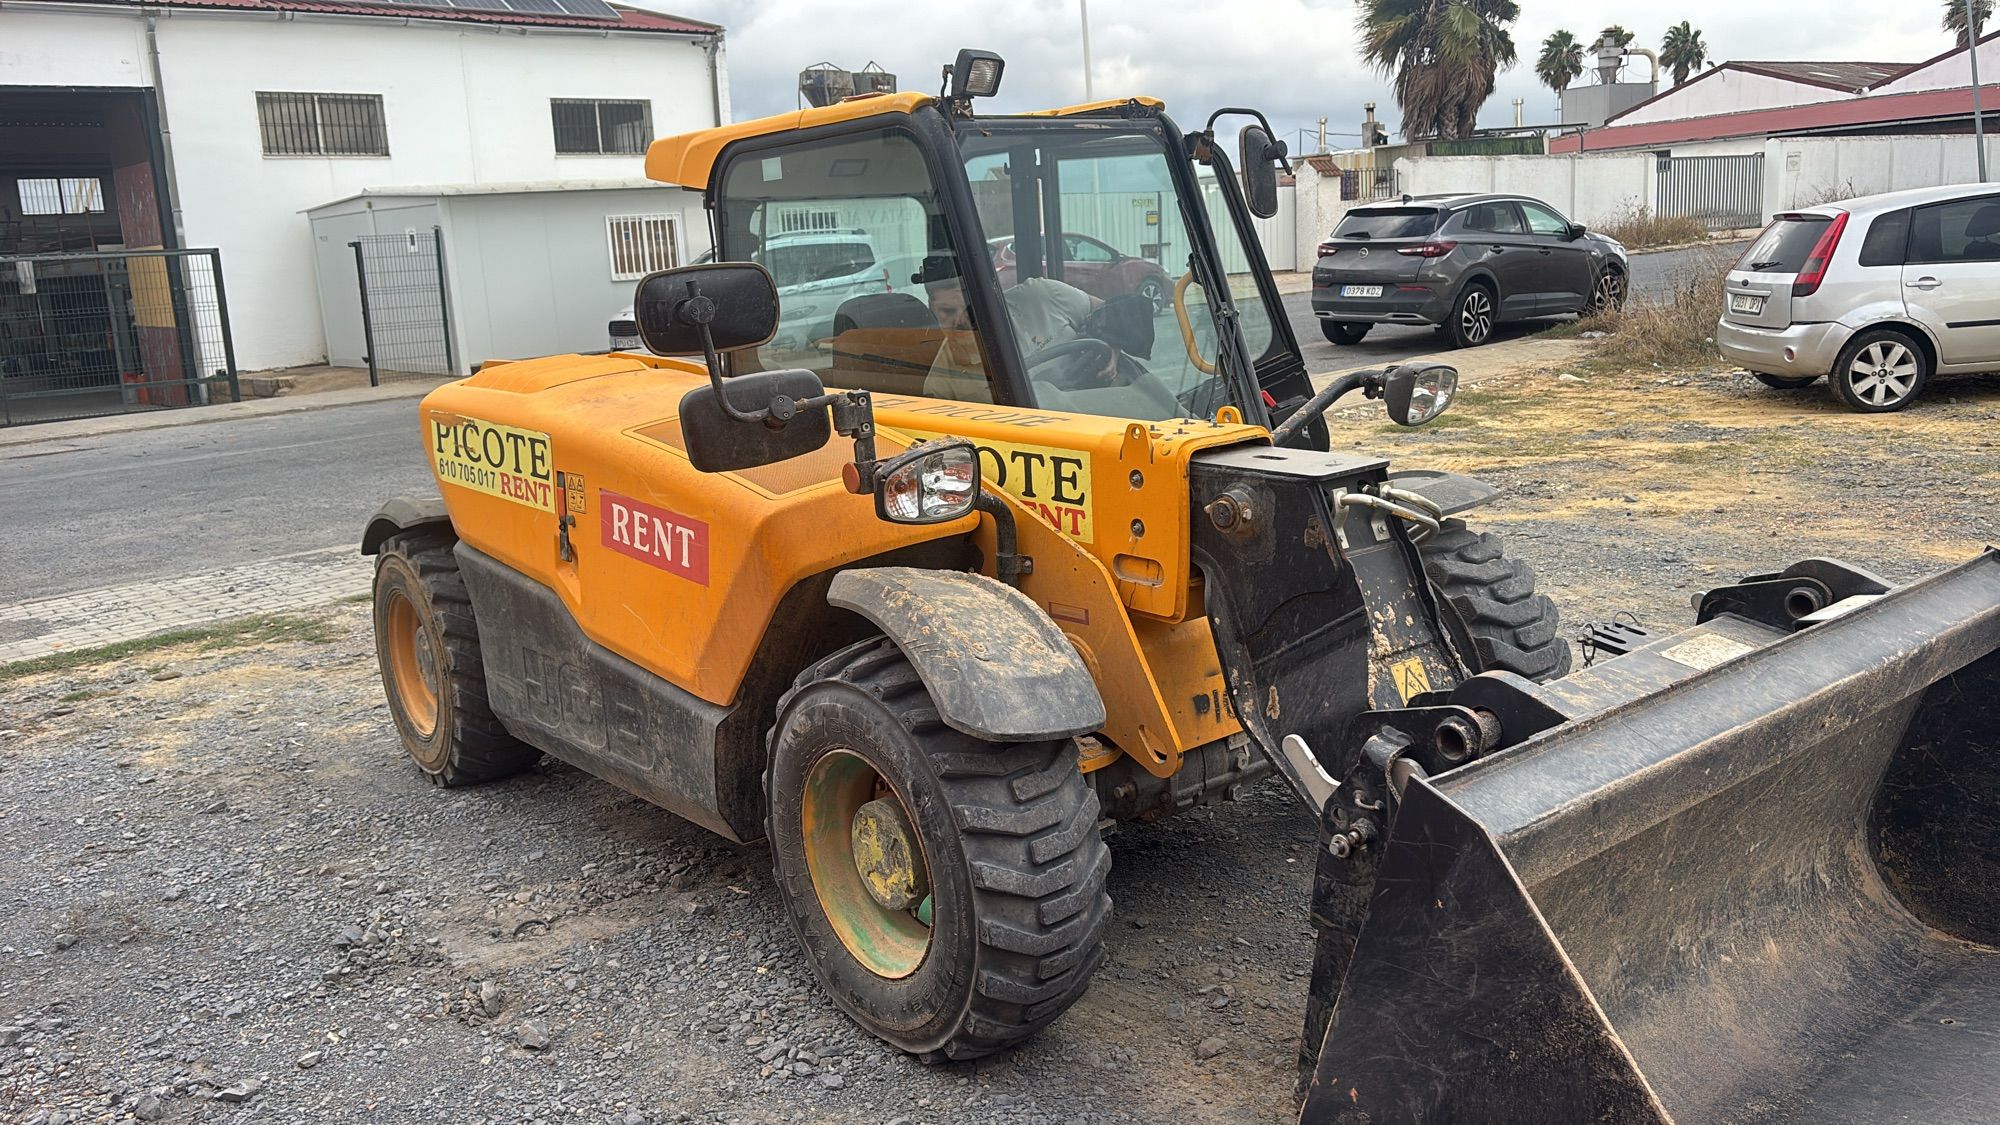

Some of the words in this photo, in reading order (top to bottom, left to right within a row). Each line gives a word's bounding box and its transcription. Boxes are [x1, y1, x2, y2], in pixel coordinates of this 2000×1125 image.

[1346, 286, 1365, 297] 0378
[1366, 286, 1382, 296] KDZ
[911, 404, 1071, 427] PICOTE
[436, 419, 551, 481] PICOTE
[439, 460, 457, 479] 610
[458, 463, 477, 484] 705
[477, 467, 496, 490] 017
[500, 472, 552, 508] RENT
[611, 502, 696, 569] RENT
[522, 646, 656, 771] JCB
